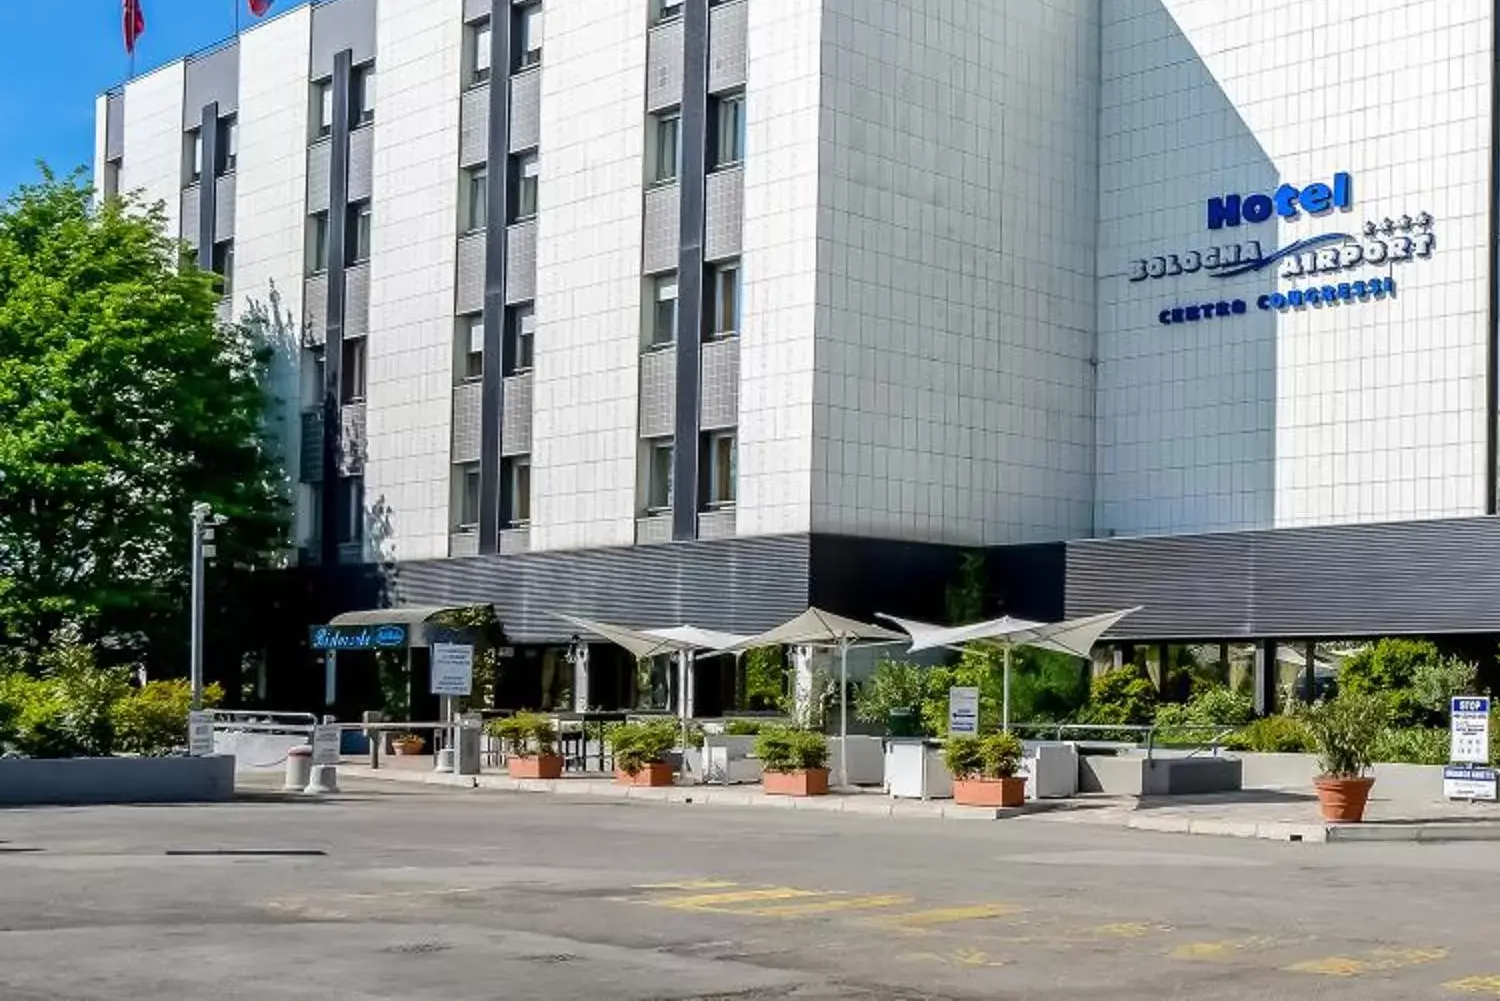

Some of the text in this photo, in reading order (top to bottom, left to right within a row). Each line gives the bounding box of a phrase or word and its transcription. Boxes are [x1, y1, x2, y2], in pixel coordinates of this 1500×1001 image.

[1207, 171, 1351, 230] Hotel
[1129, 232, 1435, 282] BOLOGNA AIRPORT
[1158, 277, 1396, 325] CENTRO CONGRESSI
[1460, 701, 1480, 710] STOP
